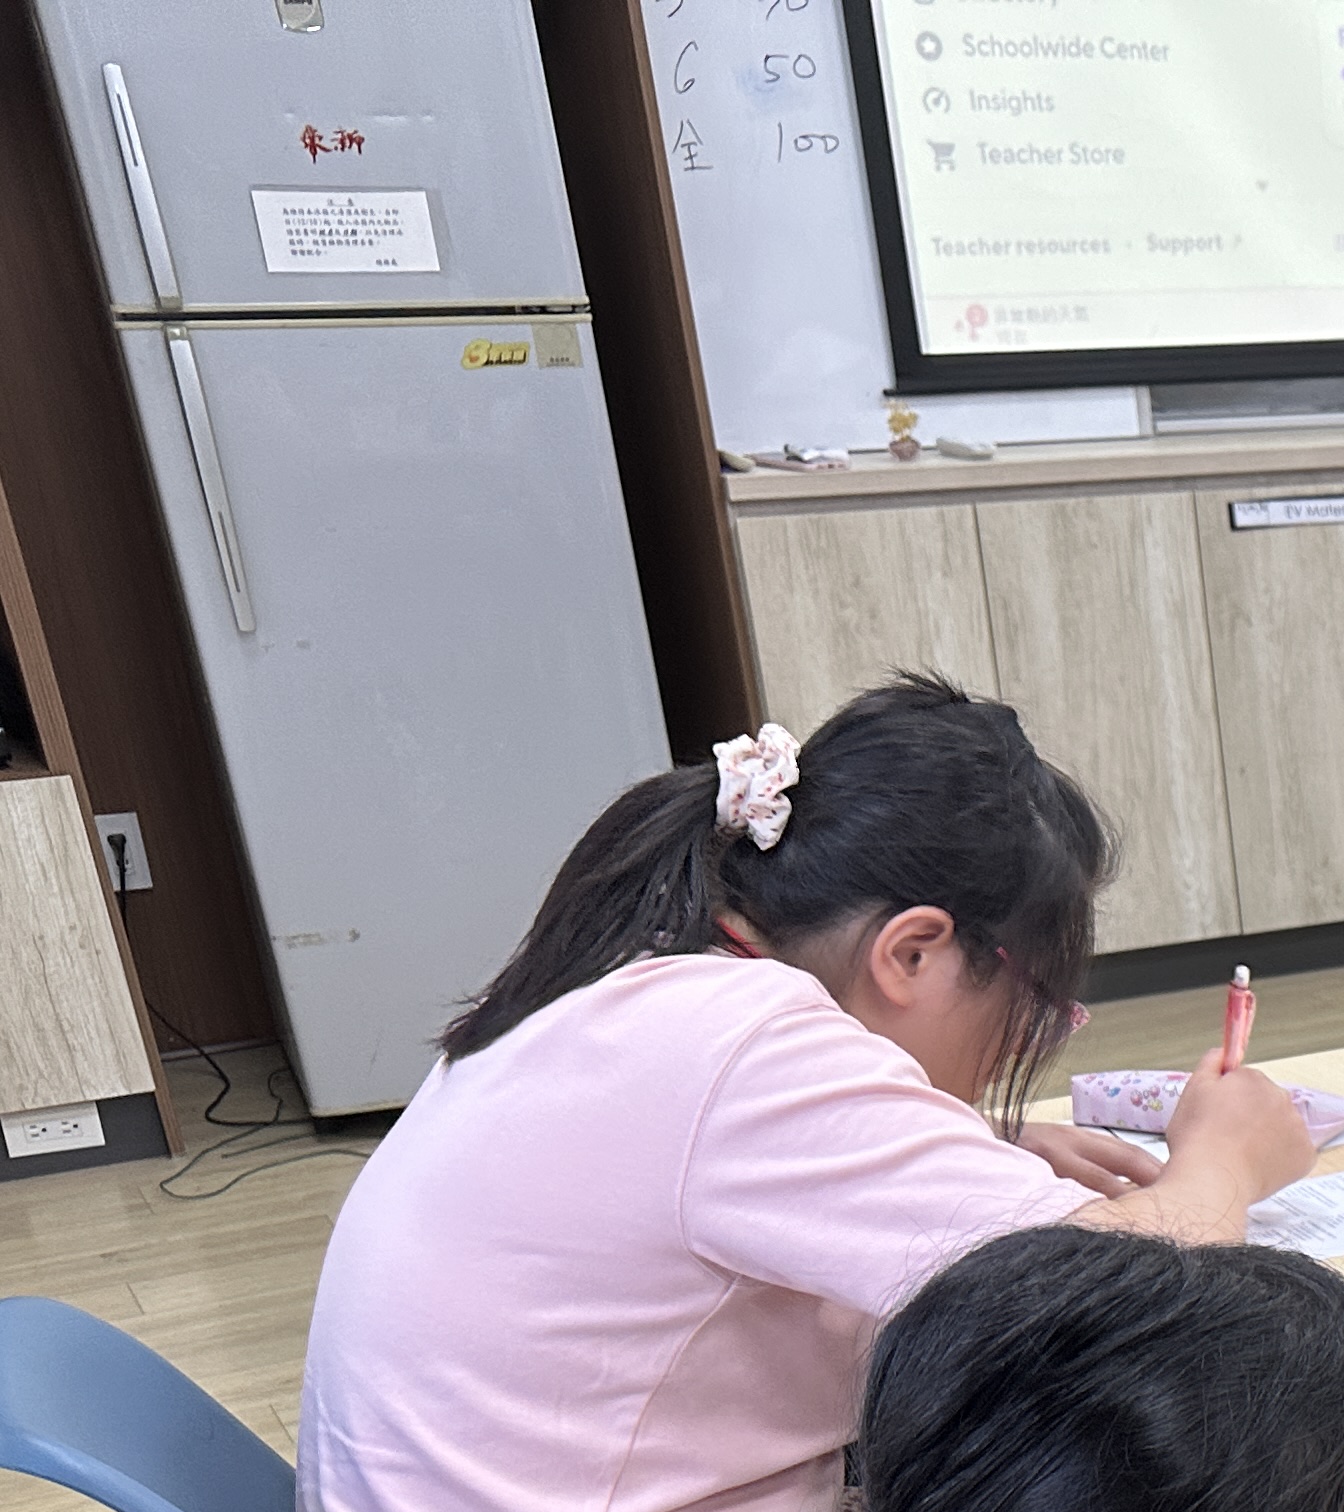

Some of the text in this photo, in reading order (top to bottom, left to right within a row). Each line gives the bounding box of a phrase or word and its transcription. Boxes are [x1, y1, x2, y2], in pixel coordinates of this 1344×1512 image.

[962, 33, 1169, 62] Schoolwide Center
[675, 40, 816, 94] 6 50
[969, 88, 1055, 117] Insights
[777, 121, 840, 163] 100
[976, 141, 1125, 165] Teacher Store
[931, 234, 1223, 258] Teacher resources Support
